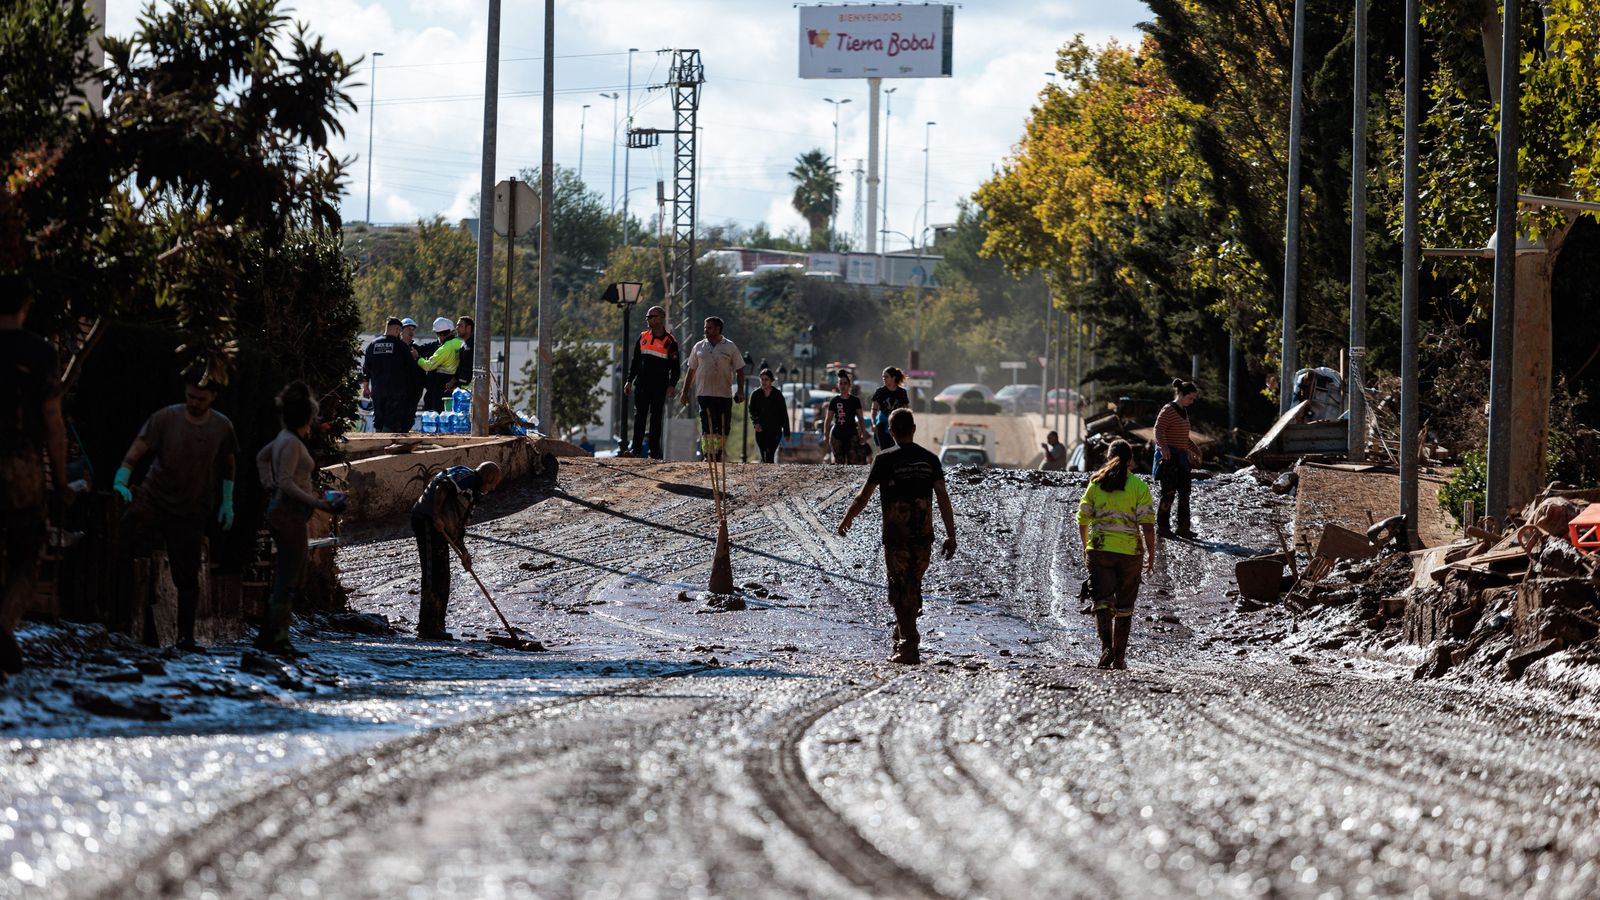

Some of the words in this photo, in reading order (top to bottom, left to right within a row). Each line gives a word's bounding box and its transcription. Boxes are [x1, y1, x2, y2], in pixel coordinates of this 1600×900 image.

[839, 13, 902, 22] BIENVENIDOS
[836, 33, 883, 51] Tierra
[887, 32, 936, 56] Bobal
